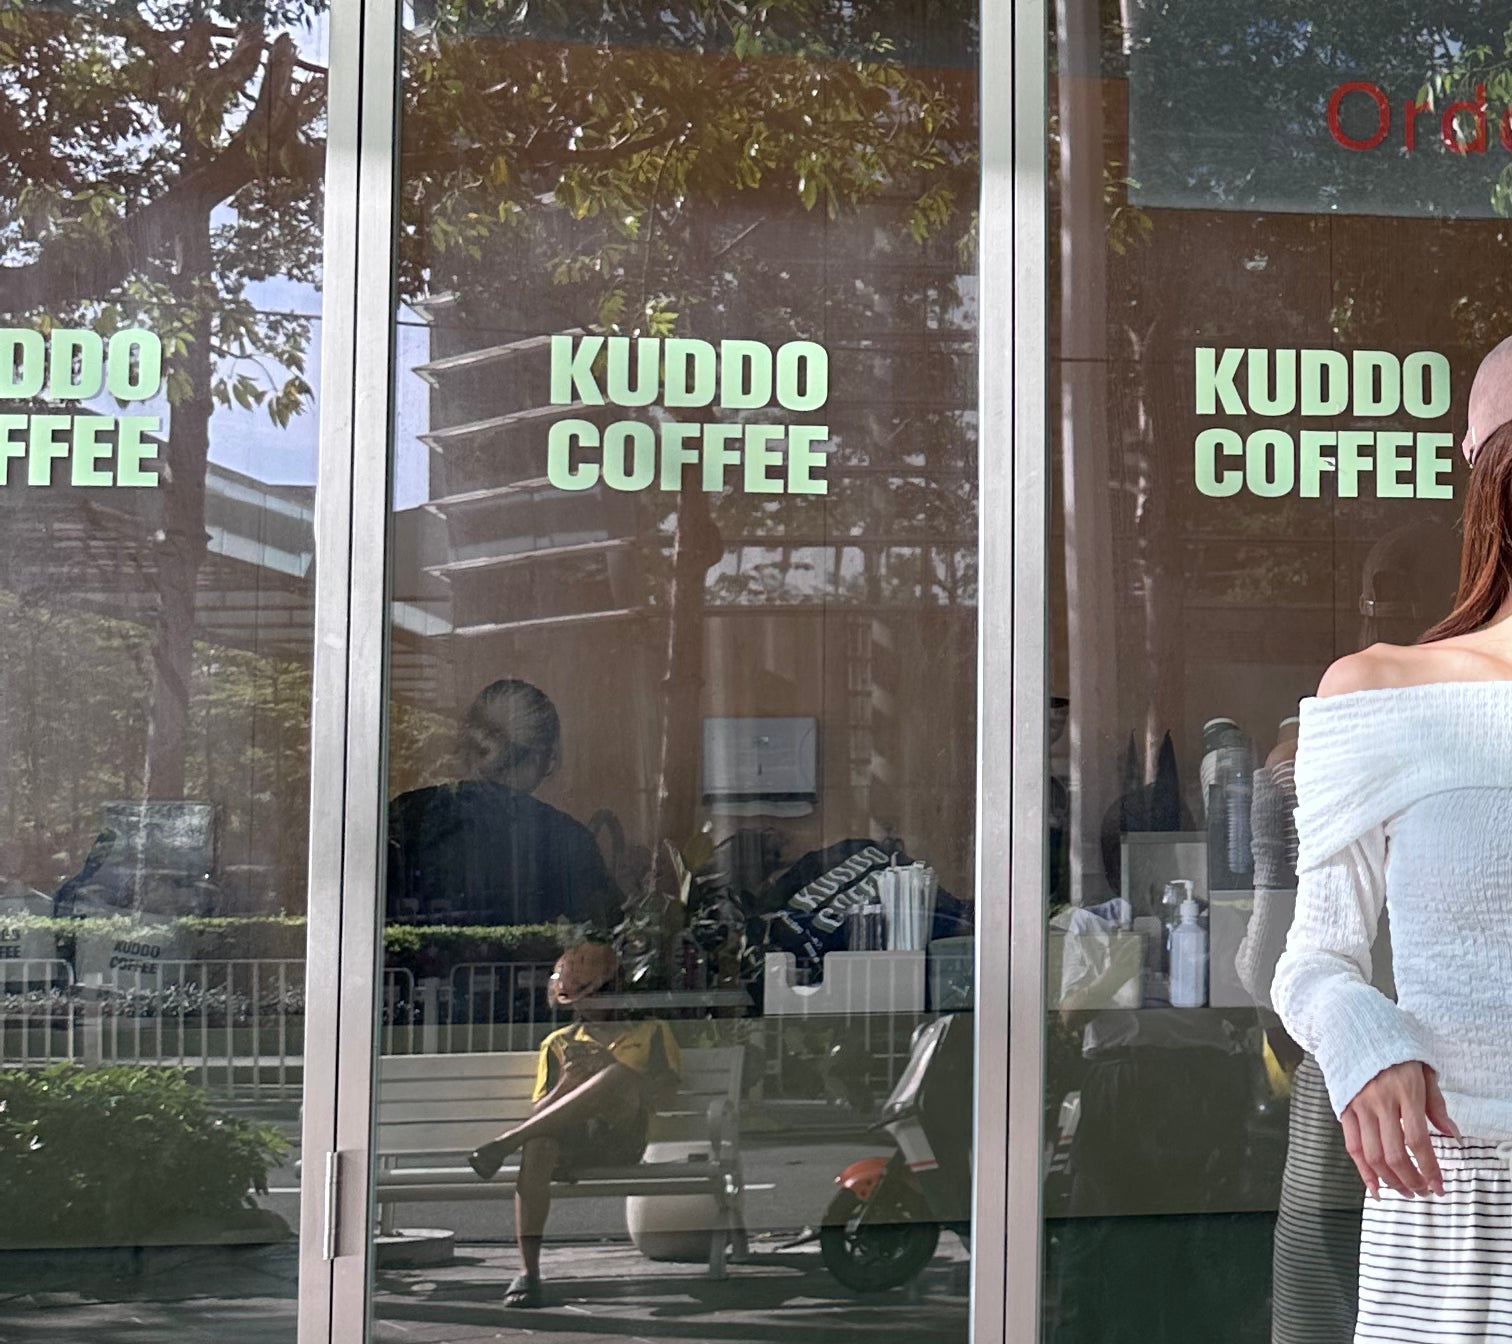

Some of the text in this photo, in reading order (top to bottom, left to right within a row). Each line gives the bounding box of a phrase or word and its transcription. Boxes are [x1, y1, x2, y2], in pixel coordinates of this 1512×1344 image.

[550, 334, 829, 412] KUDDO
[1195, 347, 1451, 419] KUDDO
[547, 418, 829, 495] COFFEE
[1194, 428, 1454, 500] COFFEE
